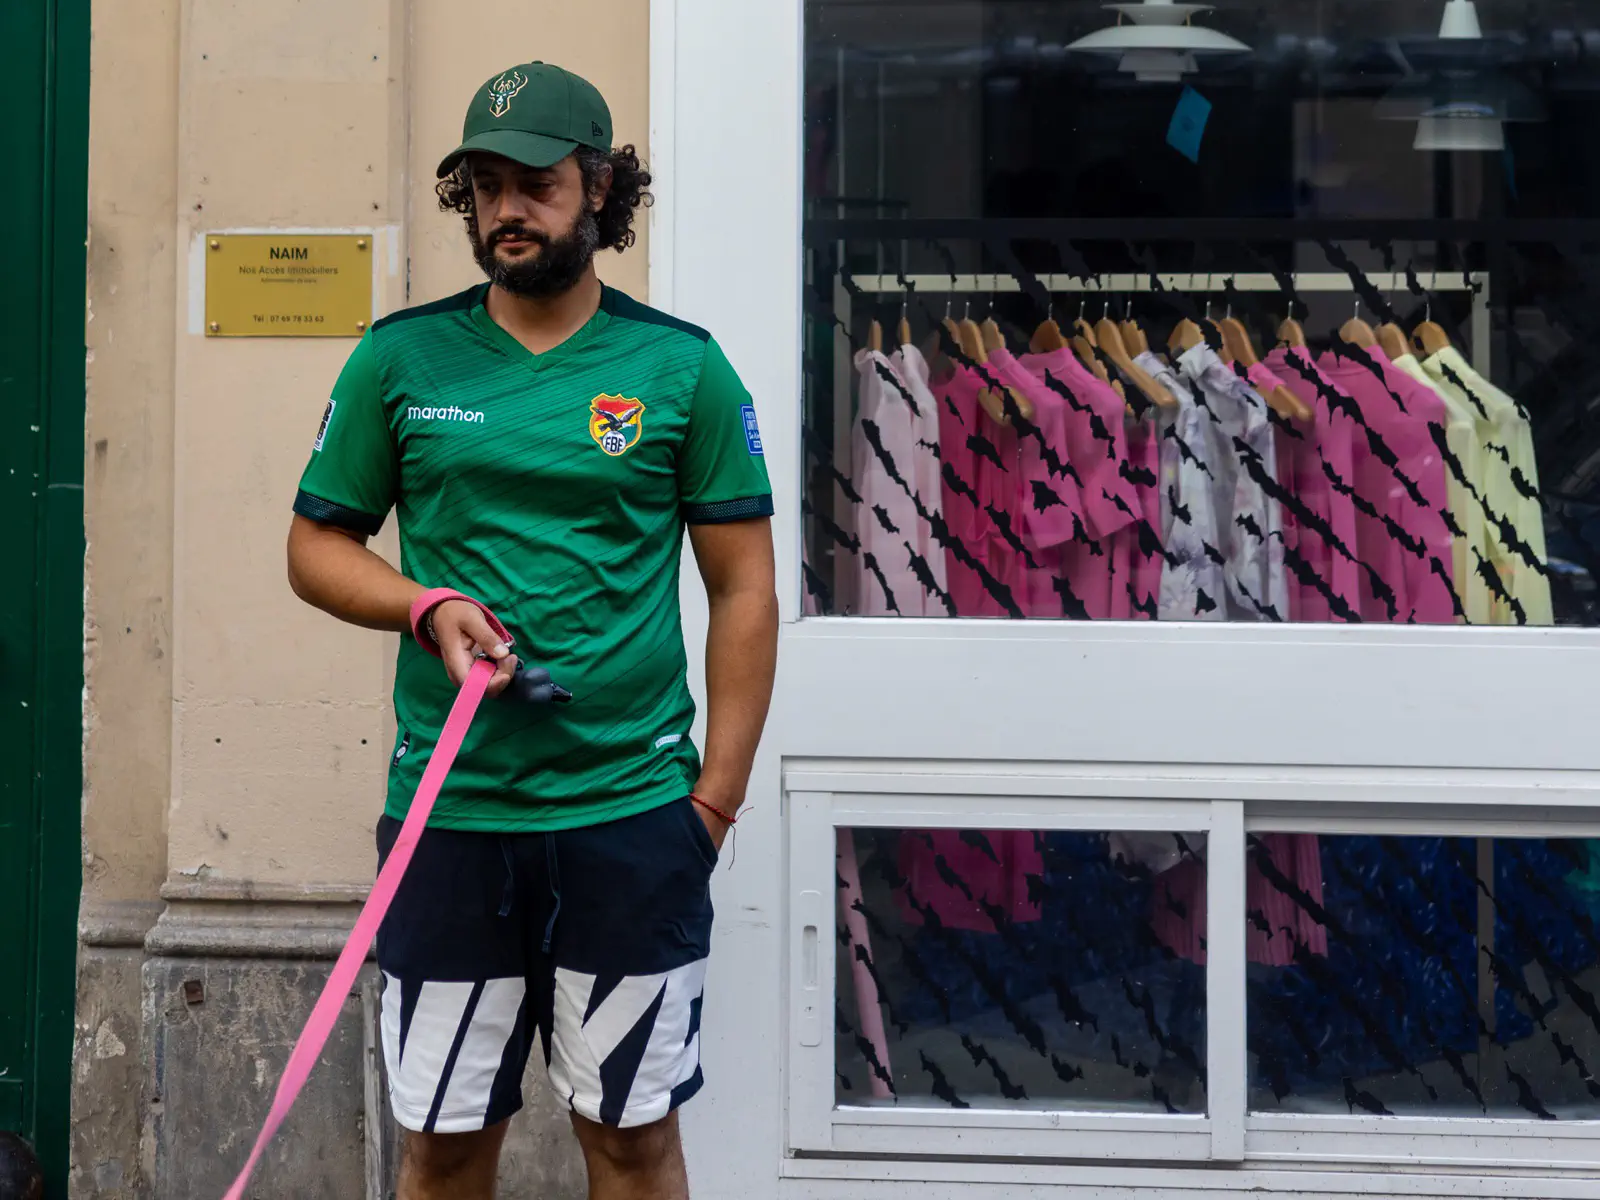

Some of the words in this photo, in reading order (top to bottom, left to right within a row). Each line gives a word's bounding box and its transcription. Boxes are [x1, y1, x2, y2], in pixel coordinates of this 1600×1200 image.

[270, 247, 308, 260] NAIM
[238, 266, 257, 275] Nos
[258, 265, 285, 275] Accès
[287, 265, 339, 275] Immobiliers
[407, 405, 485, 423] marathon
[605, 436, 624, 453] FBF
